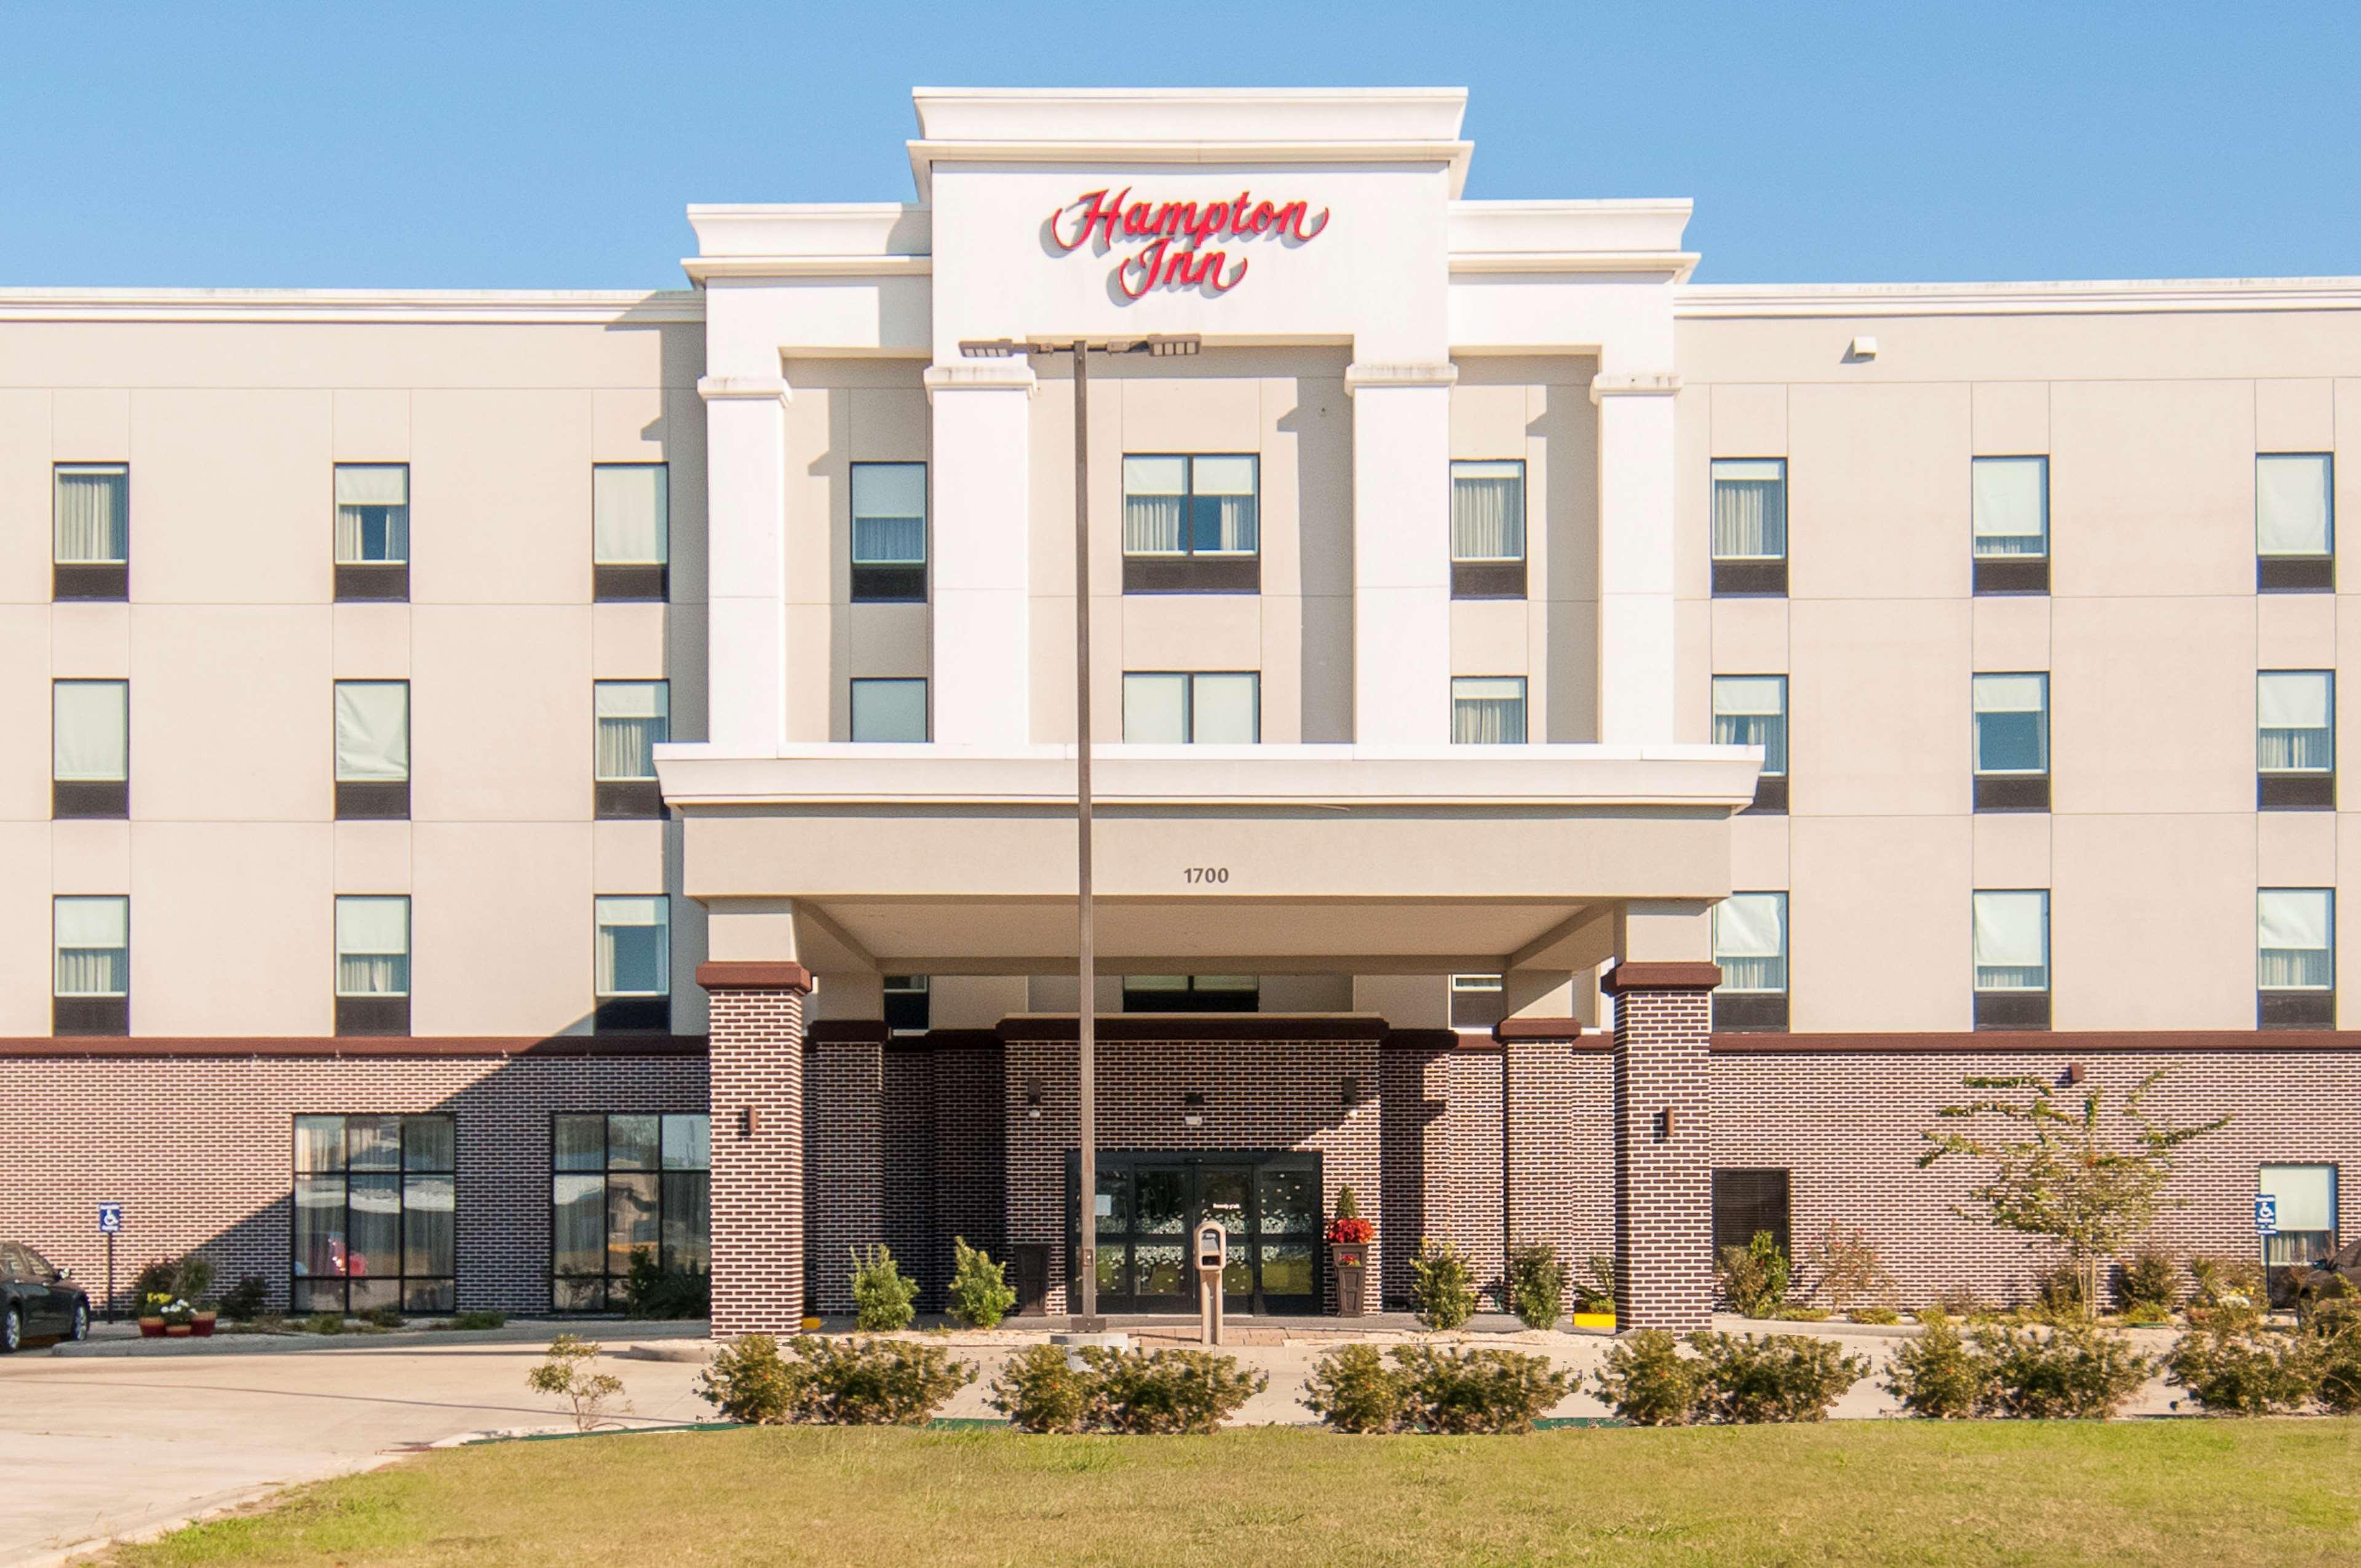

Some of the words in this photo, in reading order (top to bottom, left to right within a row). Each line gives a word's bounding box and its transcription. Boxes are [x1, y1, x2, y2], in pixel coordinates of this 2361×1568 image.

[1052, 186, 1329, 250] Hampton
[1119, 237, 1248, 299] Inn
[1183, 868, 1229, 884] 1700
